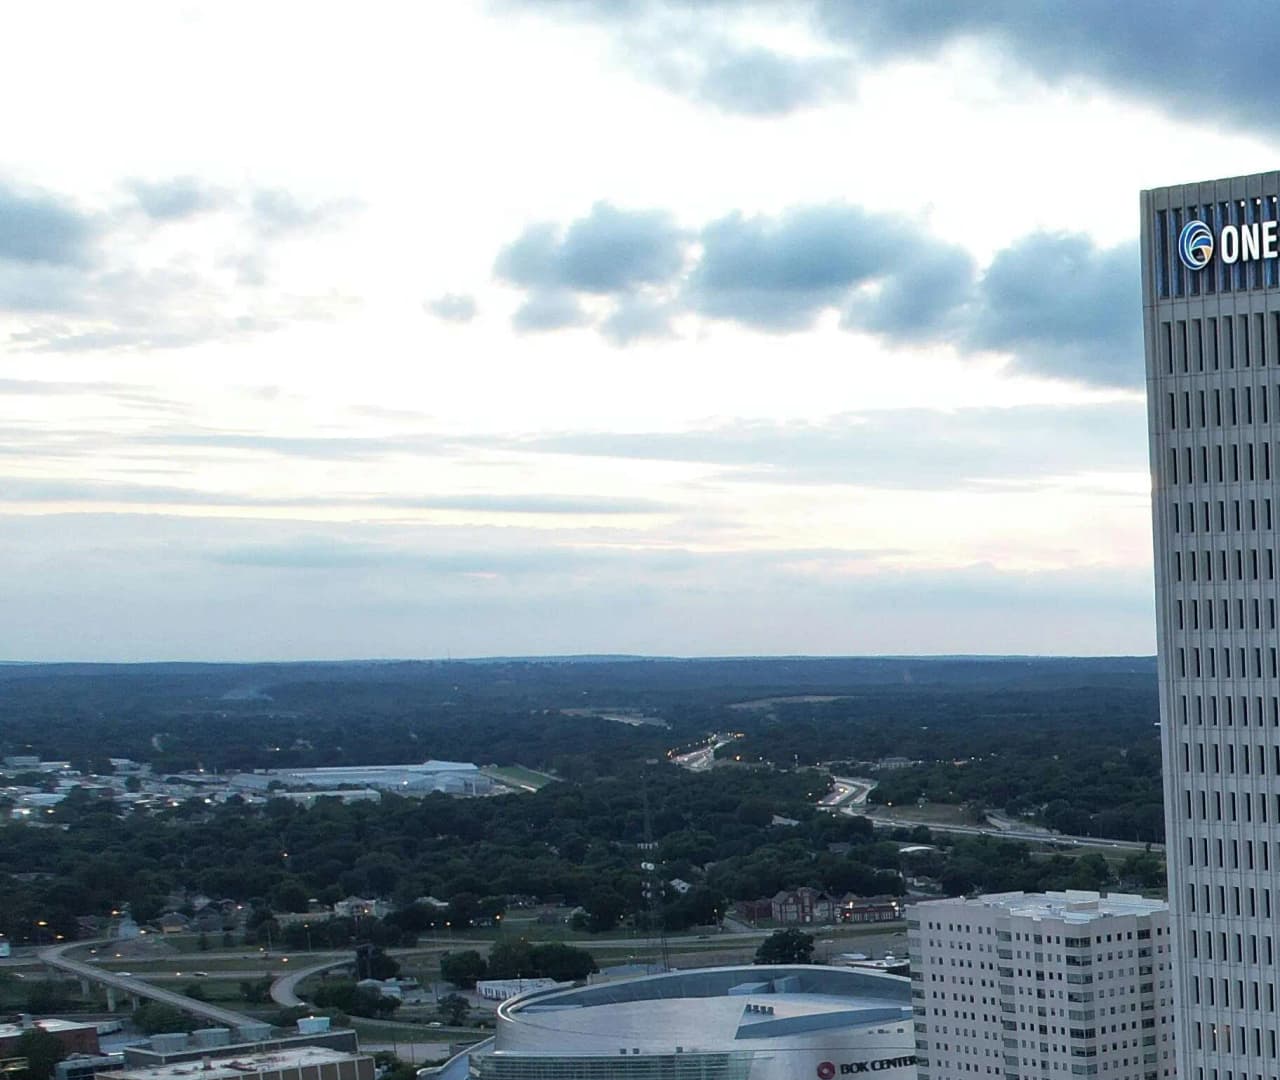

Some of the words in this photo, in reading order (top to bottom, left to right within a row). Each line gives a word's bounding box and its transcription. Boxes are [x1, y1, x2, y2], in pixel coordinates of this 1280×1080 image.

[1221, 220, 1278, 265] ONE
[841, 1061, 870, 1075] BOK
[870, 1055, 918, 1071] CENTER
